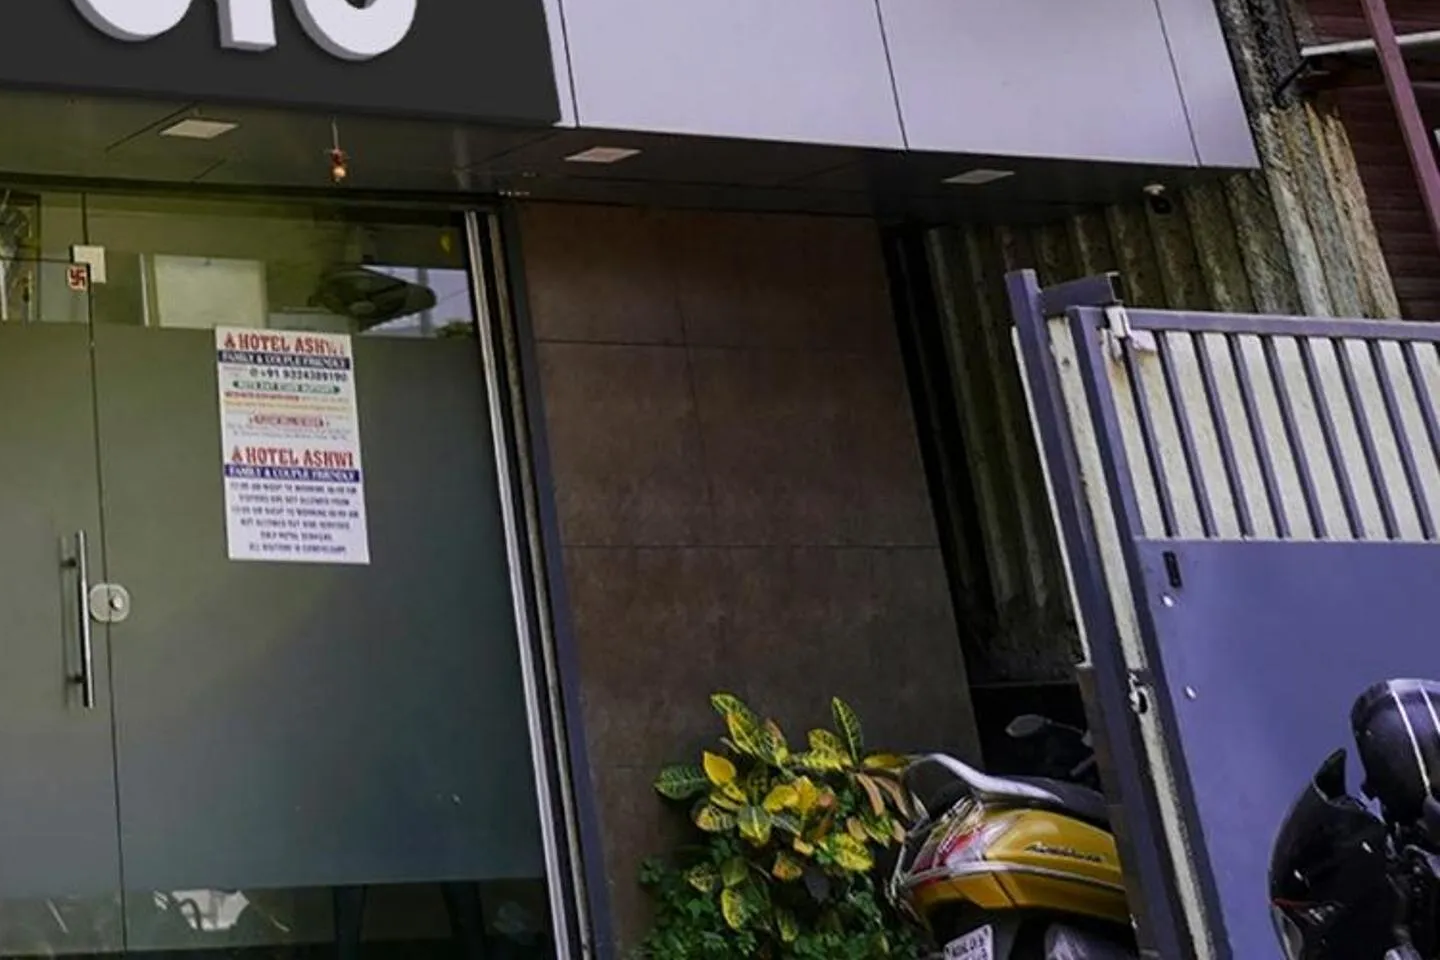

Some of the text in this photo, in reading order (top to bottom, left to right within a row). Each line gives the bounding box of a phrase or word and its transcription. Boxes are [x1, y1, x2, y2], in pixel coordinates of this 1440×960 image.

[238, 333, 290, 352] HOTEL
[245, 446, 298, 465] HOTEL
[303, 449, 354, 467] ASHWI
